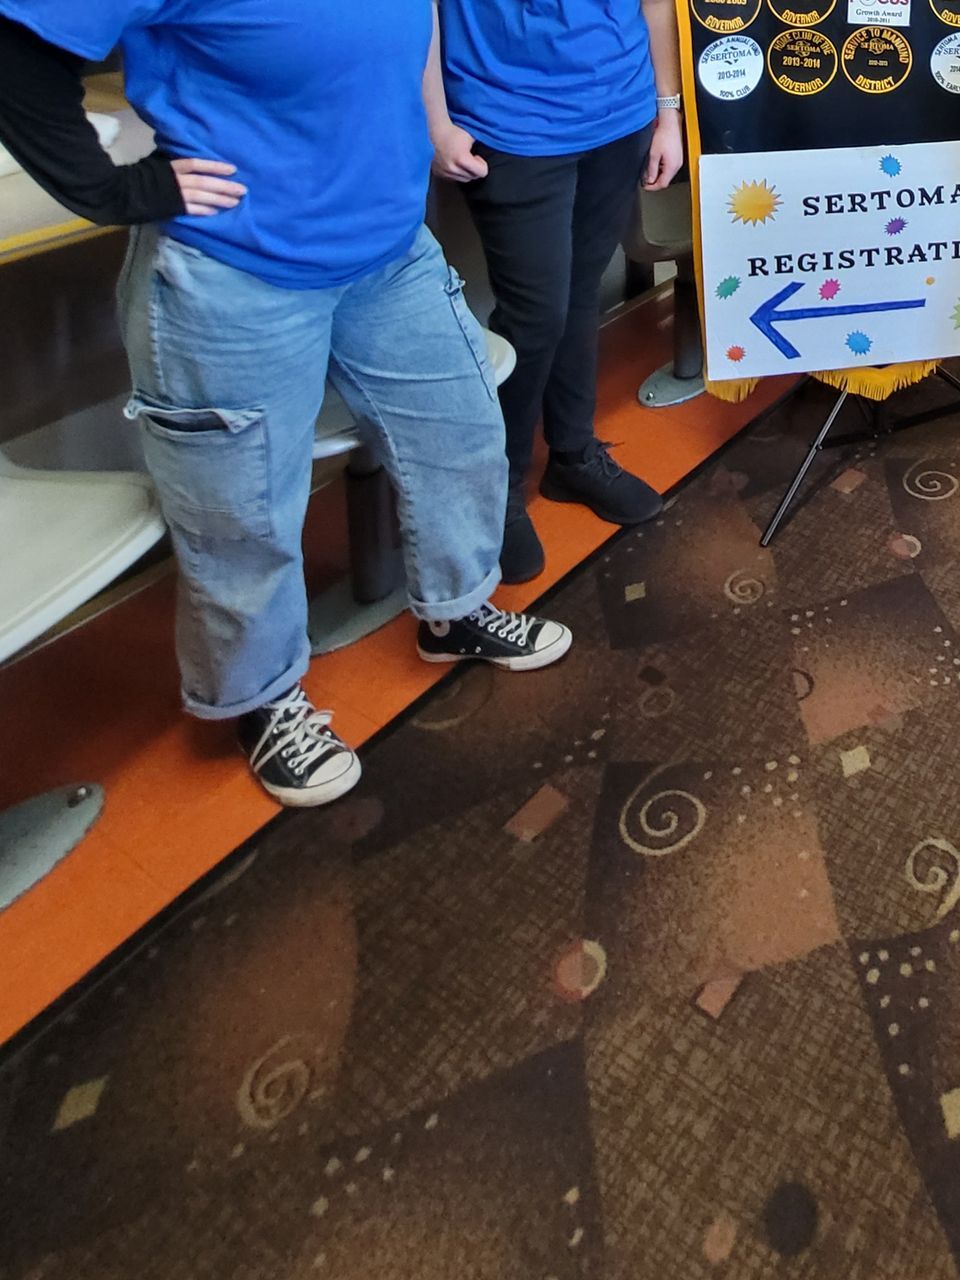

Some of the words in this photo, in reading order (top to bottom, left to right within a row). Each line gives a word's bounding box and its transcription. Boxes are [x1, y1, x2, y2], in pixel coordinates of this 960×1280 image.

[781, 9, 820, 24] GOVERNOR
[856, 8, 880, 18] Growth
[882, 10, 903, 18] Award
[704, 15, 745, 30] GOVERNOR
[773, 33, 794, 51] HOME
[792, 31, 812, 40] CLUB
[812, 34, 823, 44] OF
[820, 40, 834, 55] THE
[844, 30, 869, 60] SERVICE
[868, 28, 881, 38] TO
[881, 30, 910, 64] MANKIND
[710, 49, 752, 62] SERTOMA
[782, 56, 821, 69] 2013-2014
[778, 74, 824, 92] GOVERNOR
[855, 74, 895, 90] DISTRICT
[735, 84, 752, 97] CLUB
